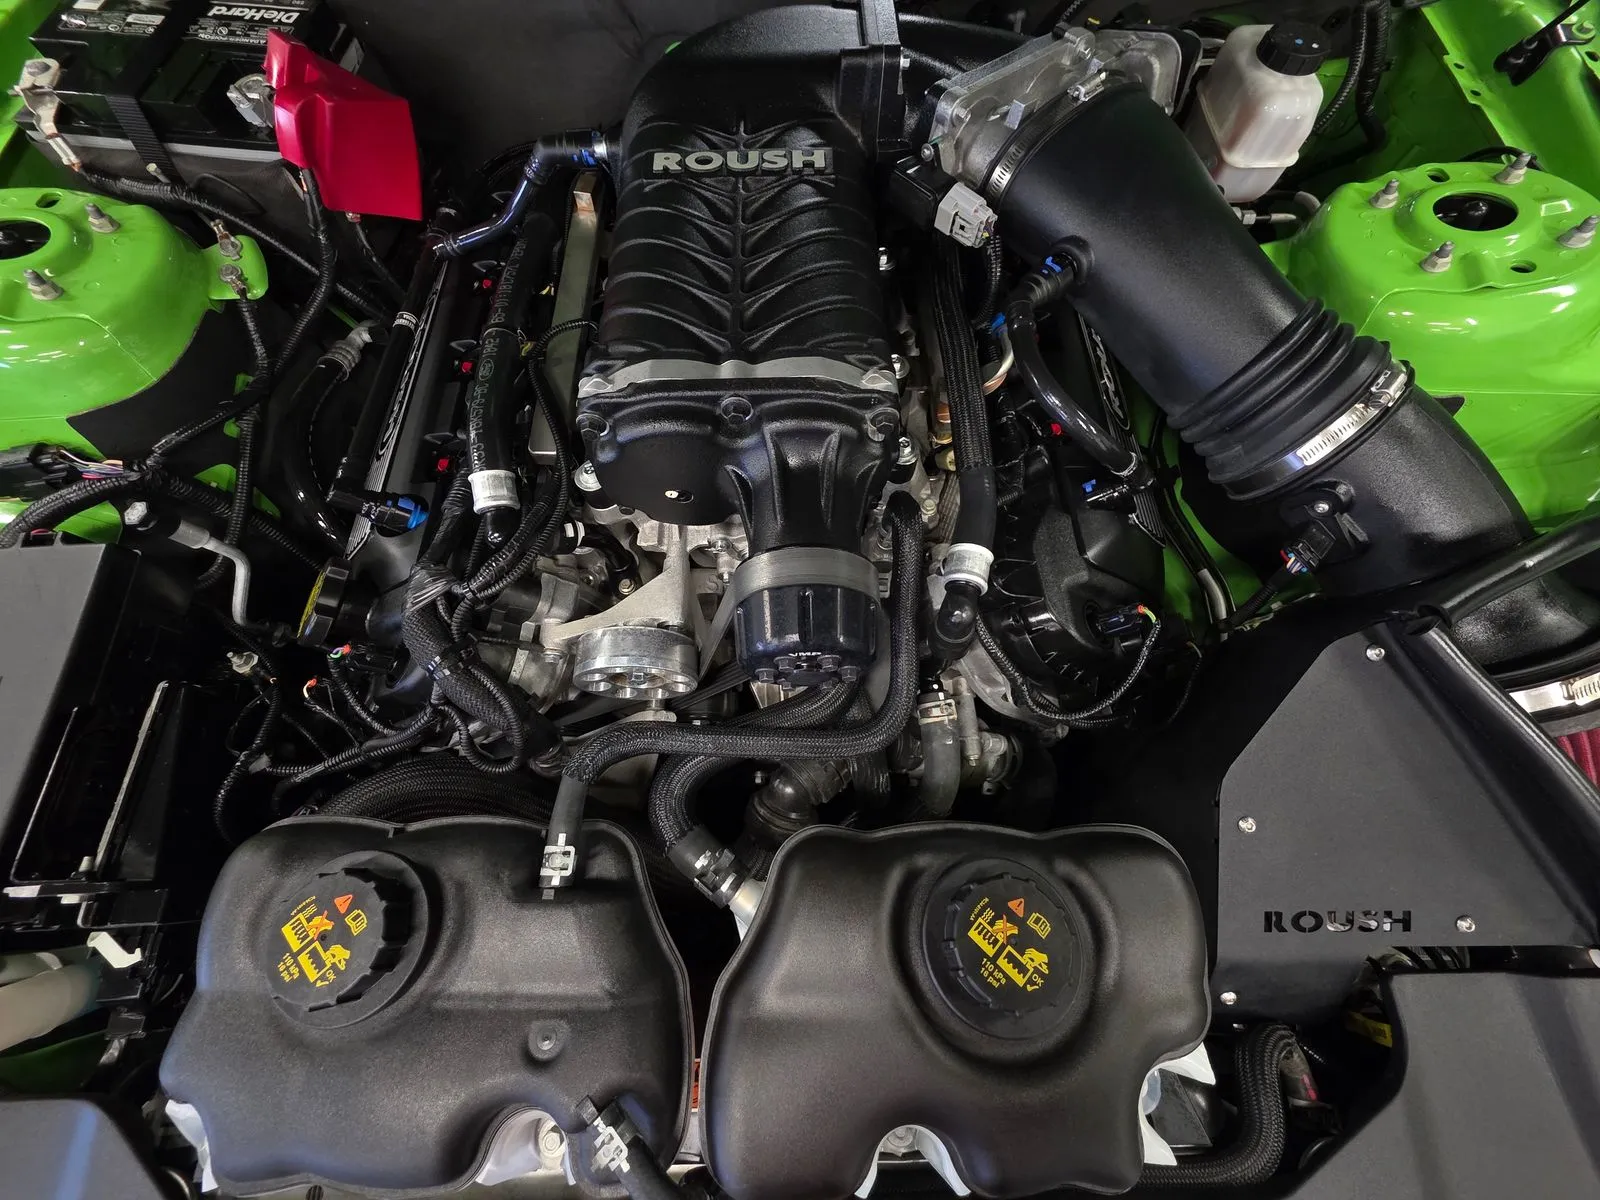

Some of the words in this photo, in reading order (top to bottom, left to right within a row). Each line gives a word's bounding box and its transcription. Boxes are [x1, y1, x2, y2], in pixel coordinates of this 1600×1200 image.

[207, 5, 300, 24] DieHard
[653, 150, 826, 173] ROUSH
[1263, 910, 1412, 933] ROUSH
[326, 969, 337, 983] OK
[981, 958, 994, 972] 110
[993, 968, 1006, 985] kPa
[1031, 973, 1044, 987] OK
[987, 976, 1000, 988] psi
